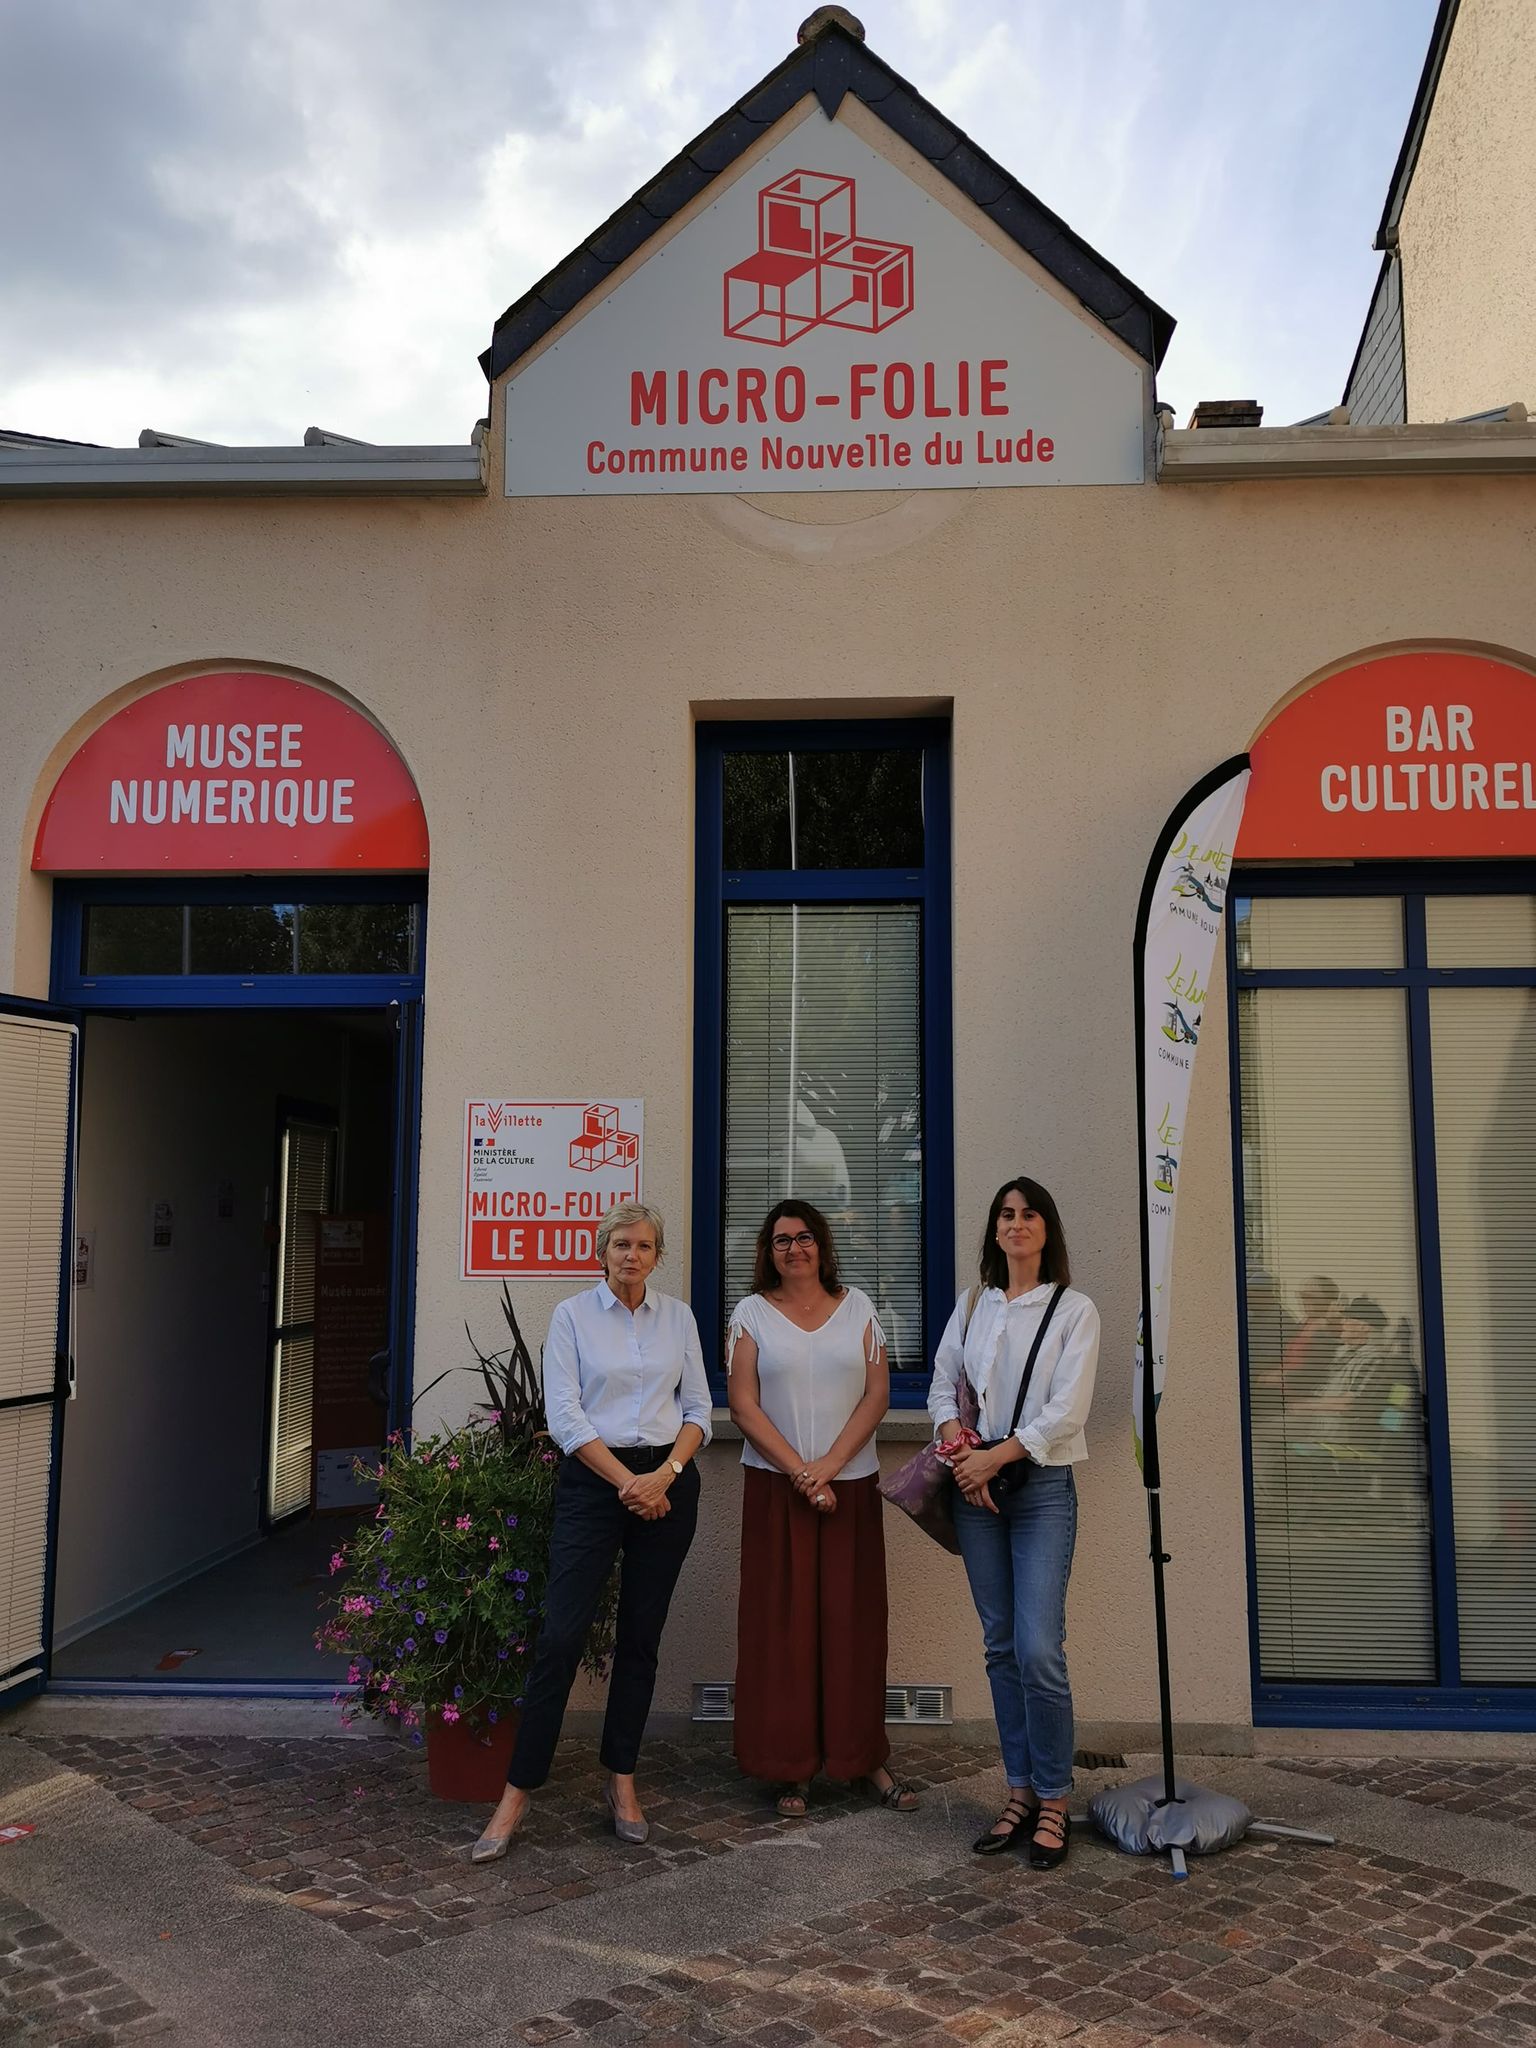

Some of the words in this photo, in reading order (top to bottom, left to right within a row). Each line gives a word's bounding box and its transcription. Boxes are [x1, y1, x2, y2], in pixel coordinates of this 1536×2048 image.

[630, 359, 1009, 426] MICRO-FOLIE
[586, 440, 747, 474] Commune
[762, 433, 911, 471] Nouvelle
[924, 431, 963, 466] du
[977, 429, 1055, 465] Lude
[166, 723, 303, 769] MUSEE
[1386, 704, 1475, 752] BAR
[110, 778, 355, 828] NUMERIQUE
[1320, 762, 1536, 812] CULTUREL
[1158, 1047, 1189, 1070] COMMUNE
[473, 1147, 517, 1156] MINISTÈRE
[473, 1157, 485, 1165] DE
[486, 1157, 497, 1165] LA
[498, 1157, 535, 1165] CULTURE
[491, 1228, 525, 1262] LE
[537, 1228, 600, 1262] LUD
